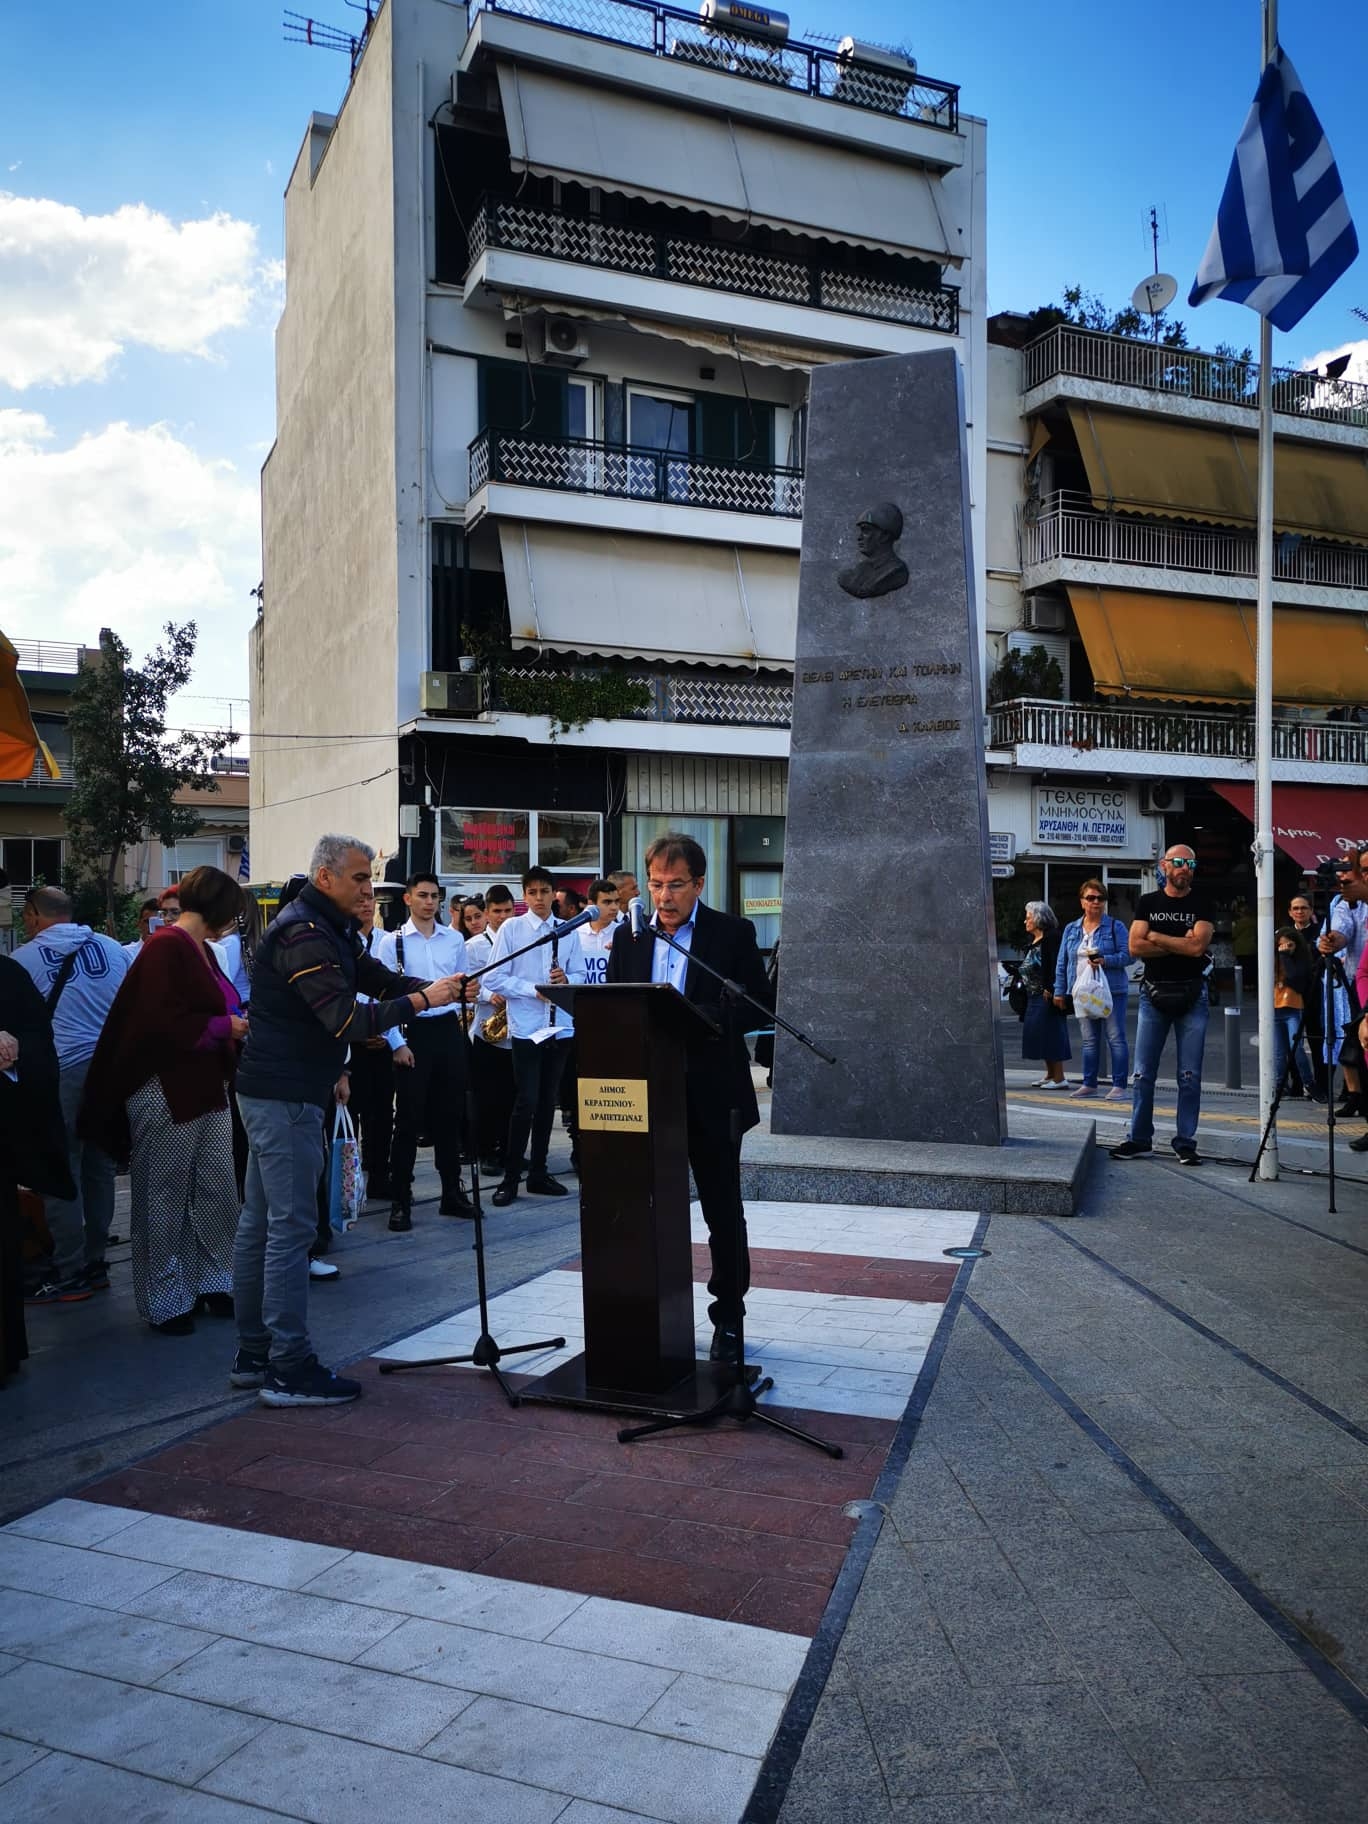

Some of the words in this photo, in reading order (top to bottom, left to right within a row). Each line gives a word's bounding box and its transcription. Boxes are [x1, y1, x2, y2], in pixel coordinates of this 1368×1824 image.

[1039, 820, 1078, 832] ΧΡΥΣΑΝΘΗ
[1092, 822, 1125, 834] ΠΕΤΡΑΚΗ
[599, 1086, 626, 1094] ΔΗΜΟΣ
[590, 1112, 643, 1122] ΔΡΑΠΕΤΣΩΝΑΣ
